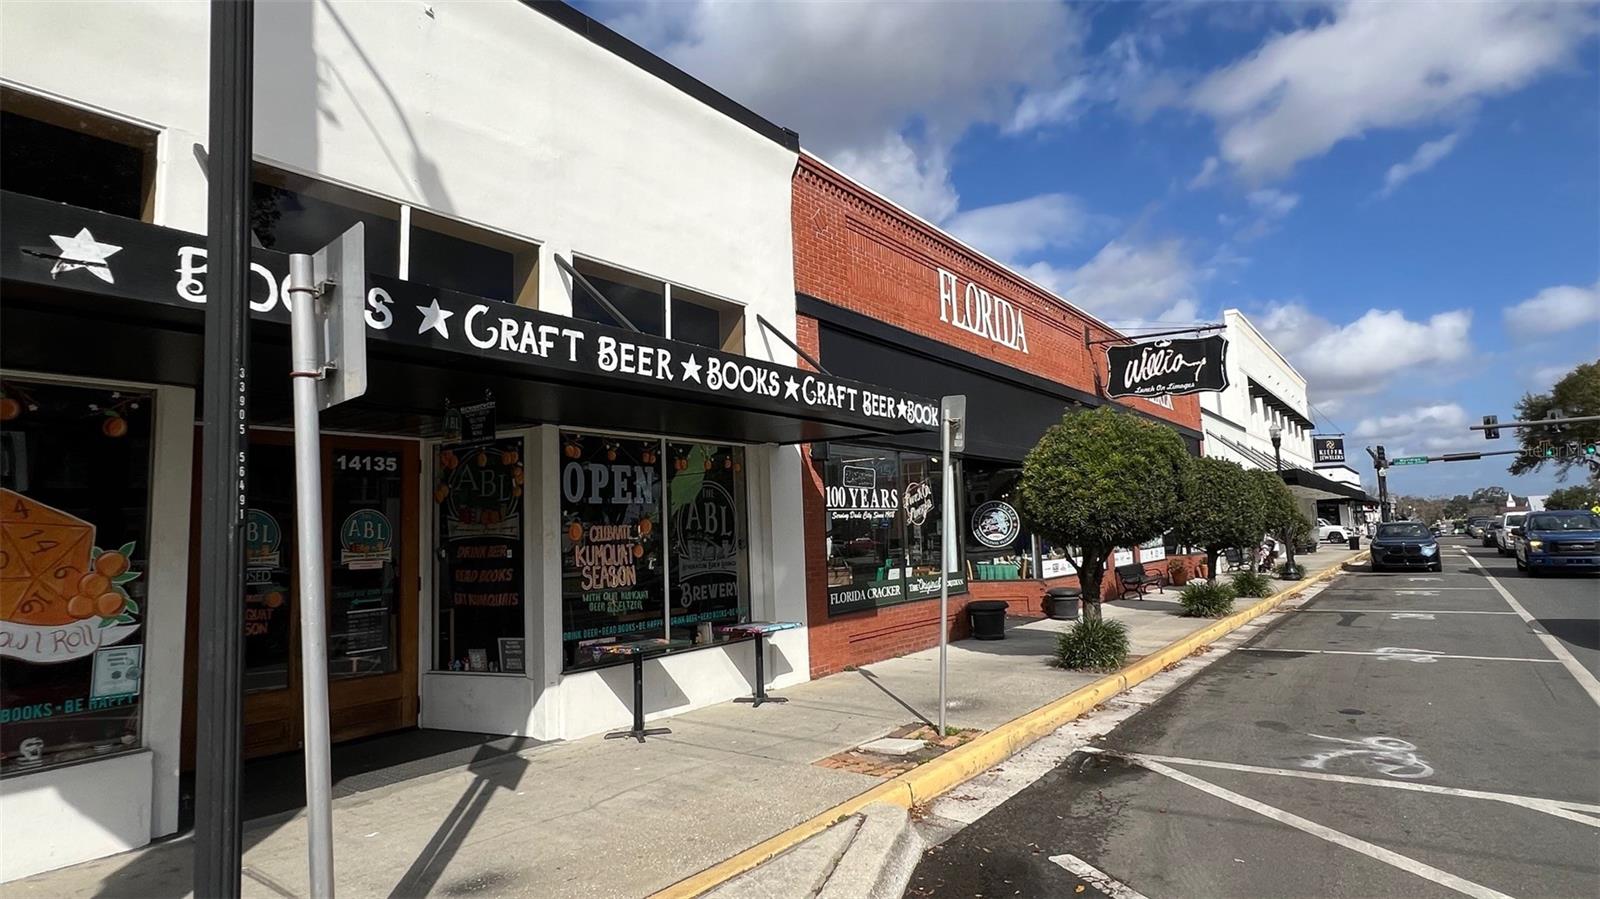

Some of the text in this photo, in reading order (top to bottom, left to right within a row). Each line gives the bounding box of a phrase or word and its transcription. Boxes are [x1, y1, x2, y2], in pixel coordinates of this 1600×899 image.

[937, 267, 1028, 354] FLORIDA
[175, 246, 940, 426] BOS CRAFT BEER BOOKS CRAFT BEER BOOK
[337, 455, 397, 471] 14135
[455, 464, 511, 501] ABL
[563, 461, 657, 504] OPEN
[14, 499, 30, 520] 4
[825, 486, 899, 508] 100 YEARS
[246, 521, 273, 543] BL
[348, 519, 385, 541] ABL
[685, 501, 732, 537] ABL
[575, 543, 634, 567] KUMQUAT
[581, 565, 637, 591] SEASON
[680, 581, 738, 608] BREWERY
[830, 585, 901, 605] FLORIDA CRACKER
[53, 625, 95, 654] Roll
[0, 703, 52, 723] BOOKS
[64, 697, 84, 713] BE
